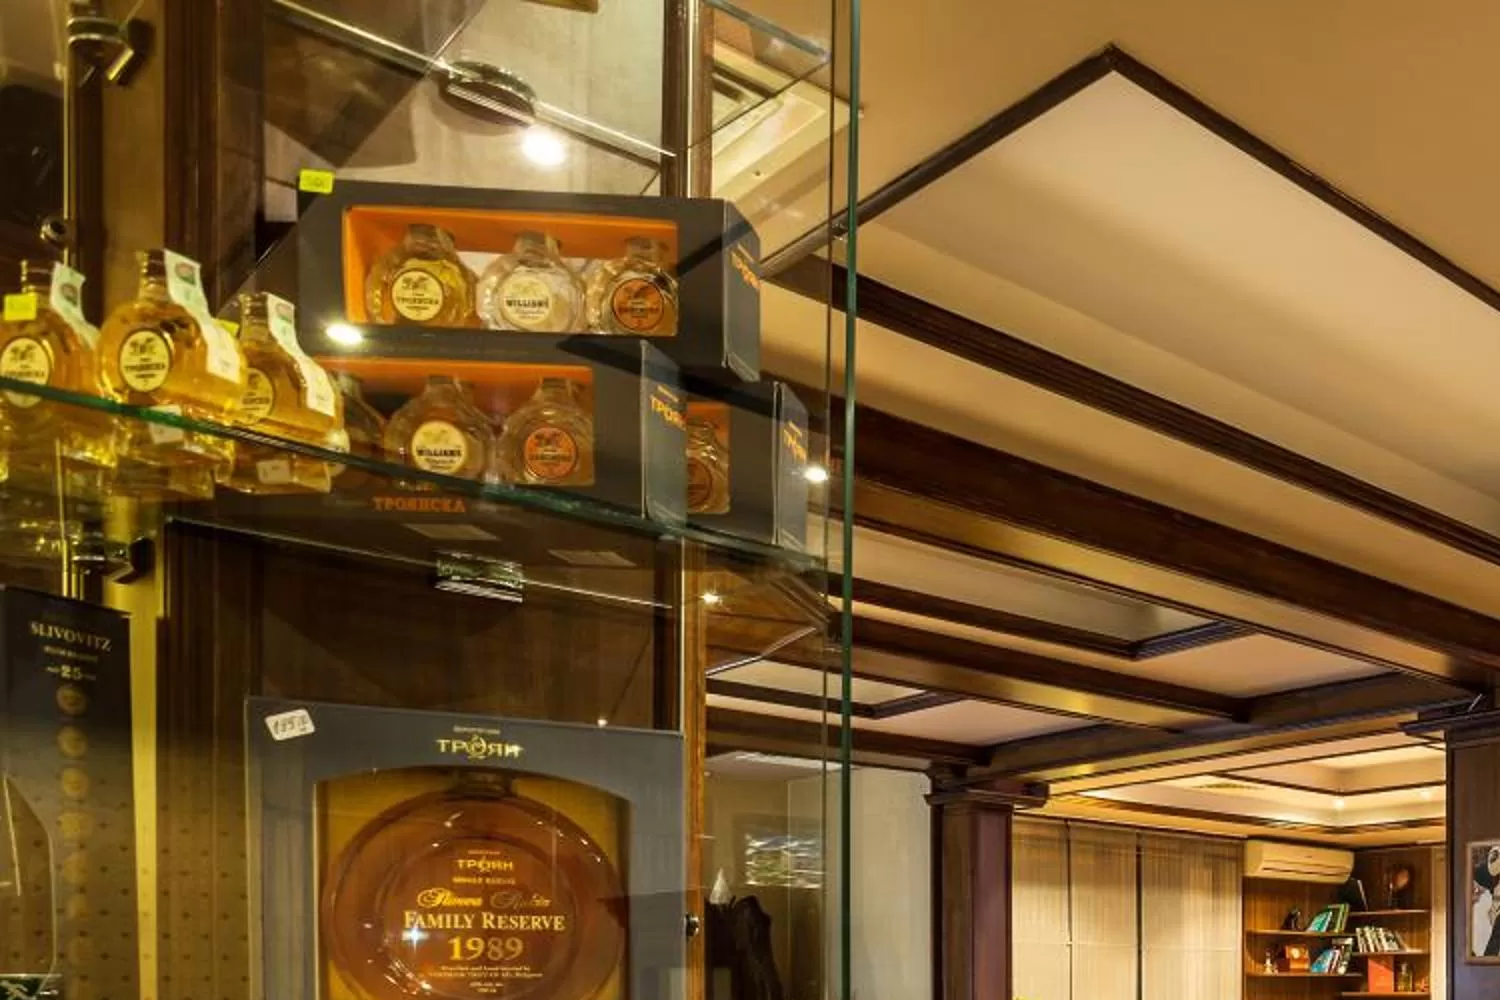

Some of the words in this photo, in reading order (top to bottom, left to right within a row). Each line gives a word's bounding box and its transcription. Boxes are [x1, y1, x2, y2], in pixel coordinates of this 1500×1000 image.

[30, 621, 113, 652] SLIVOVITZ
[436, 734, 522, 759] ТРОЯН
[404, 909, 476, 929] FAMILY
[481, 911, 566, 931] RESERVE
[448, 935, 524, 961] 1989
